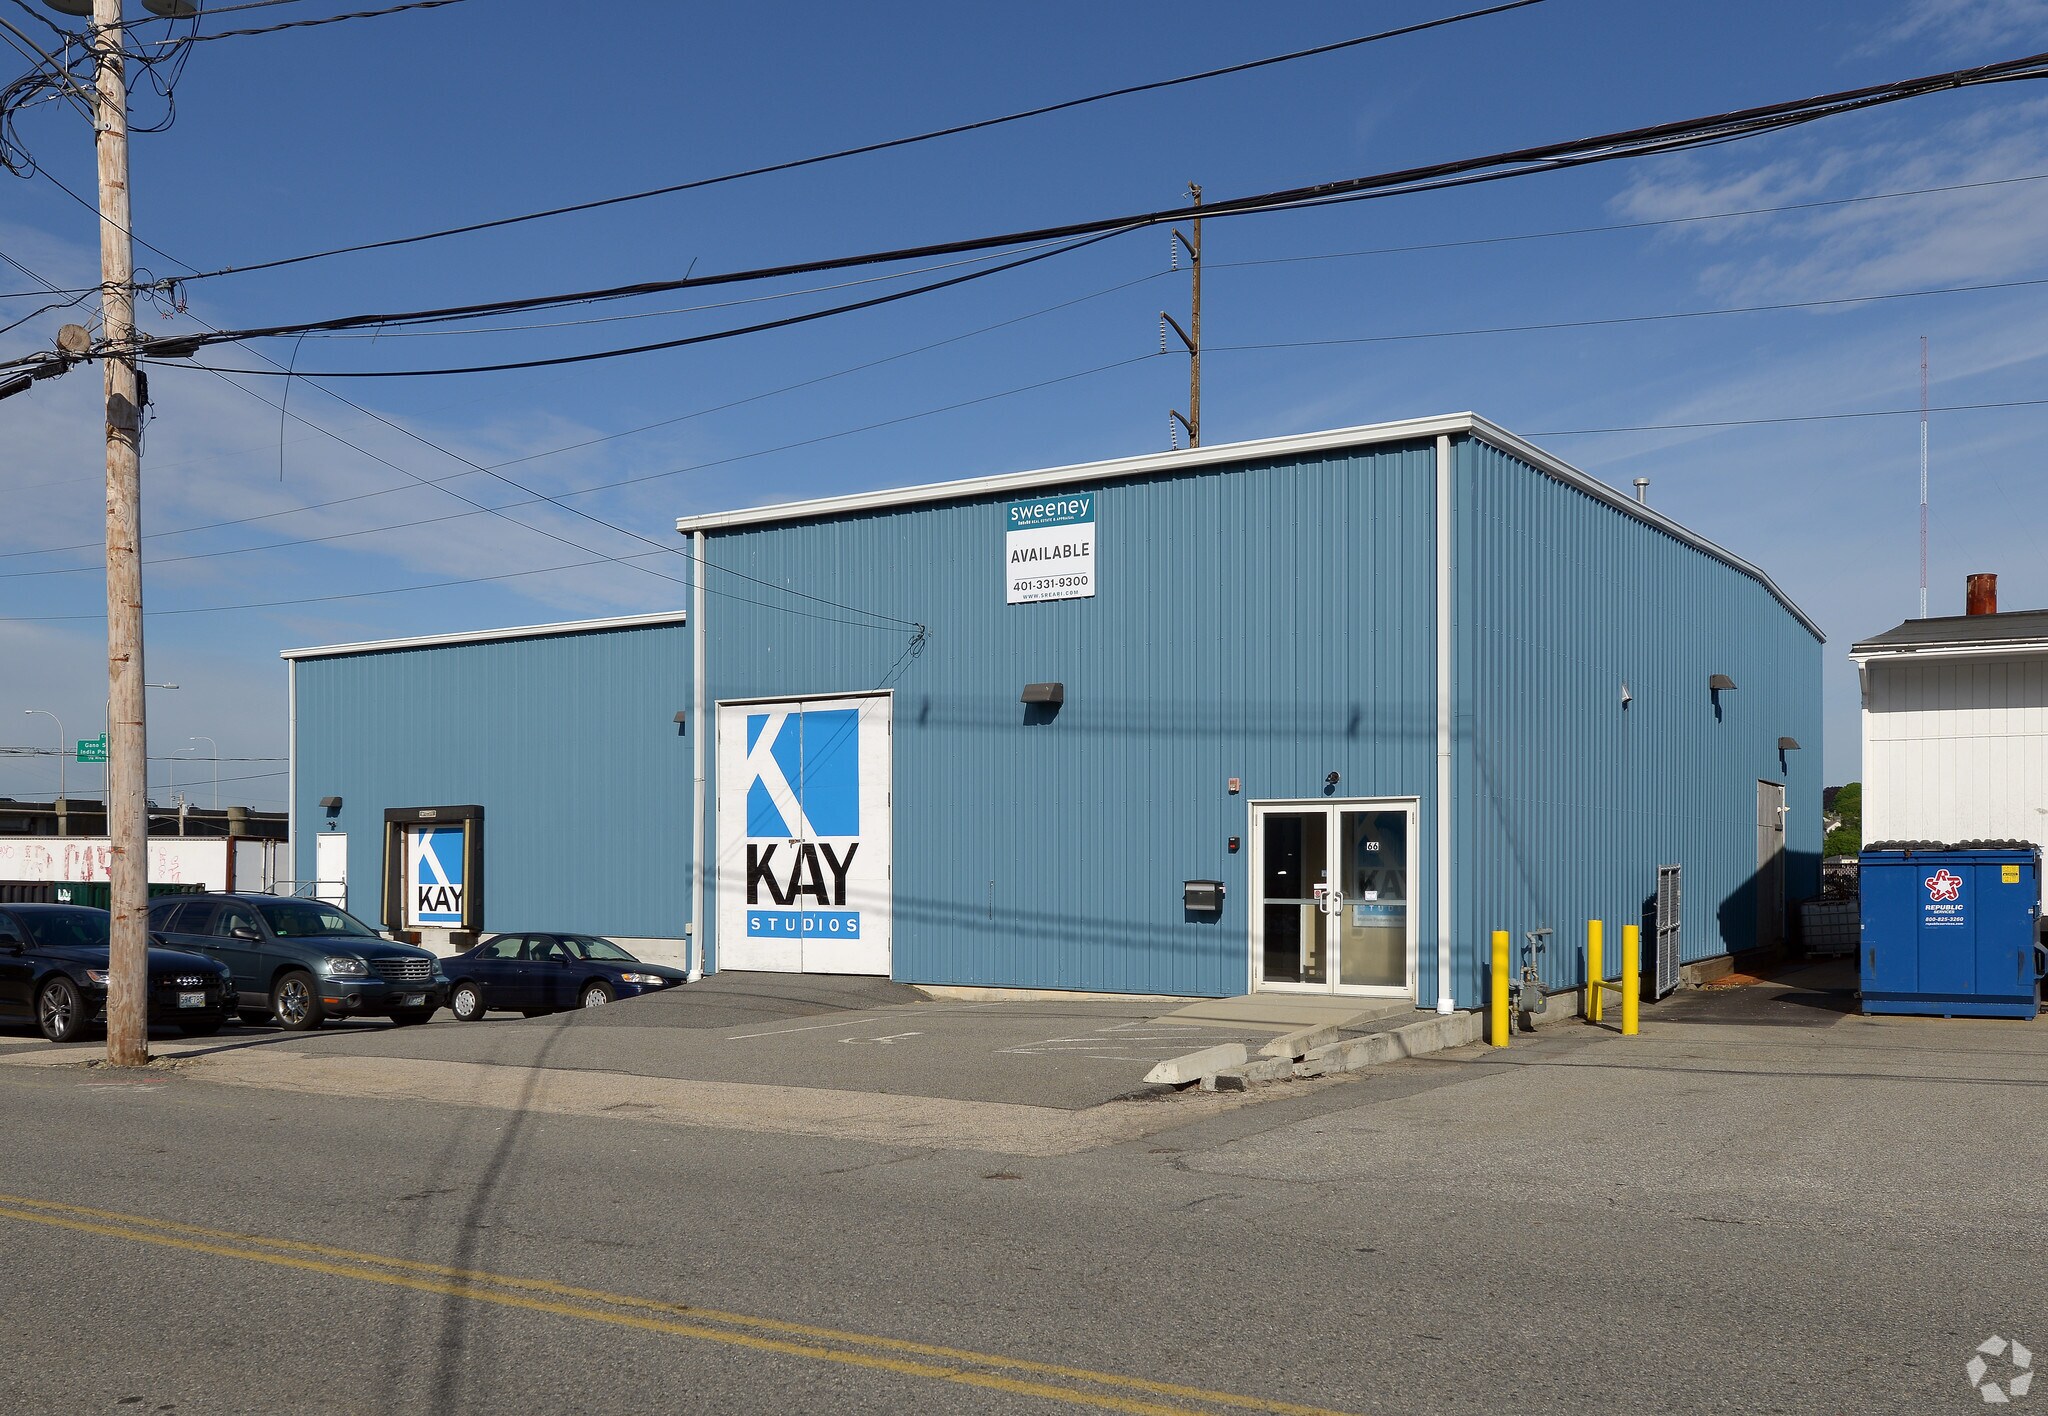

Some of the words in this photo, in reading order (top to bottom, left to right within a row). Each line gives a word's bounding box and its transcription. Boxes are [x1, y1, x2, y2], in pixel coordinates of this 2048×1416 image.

[1011, 498, 1090, 521] sweeney
[1011, 542, 1090, 564] AVAILABLE
[1013, 575, 1089, 592] 401-331-9300
[1367, 841, 1379, 851] 66
[746, 842, 860, 906] KAY
[418, 886, 463, 912] KAY
[750, 917, 858, 933] STUDIOS
